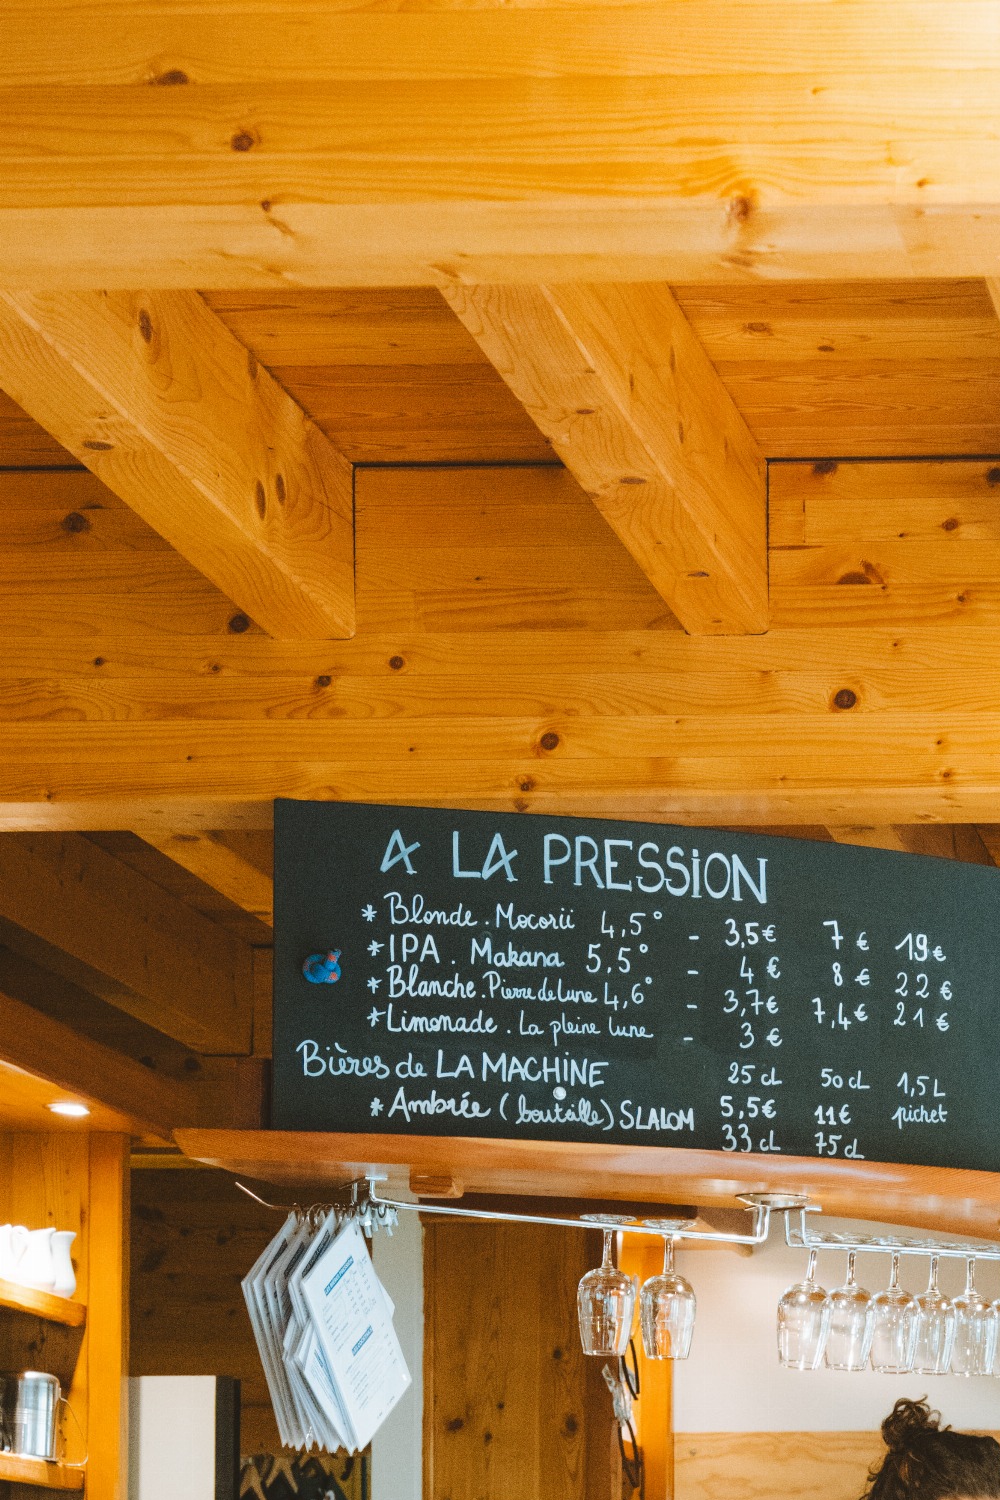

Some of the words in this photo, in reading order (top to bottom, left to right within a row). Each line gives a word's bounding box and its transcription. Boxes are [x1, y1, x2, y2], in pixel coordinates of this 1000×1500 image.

[380, 829, 421, 874] A
[453, 831, 518, 882] LA
[384, 892, 478, 925] Blonde
[390, 934, 440, 963] IPA
[471, 937, 565, 968] Makana
[387, 965, 476, 998] Blanche
[388, 1004, 497, 1034] Limonade
[520, 1011, 544, 1036] La
[549, 1016, 601, 1046] pleine
[297, 1039, 390, 1079] Bières
[396, 1053, 427, 1079] de
[437, 1050, 475, 1079] LA
[388, 1086, 491, 1123] Ambrée
[620, 1100, 694, 1132] SLALOM
[892, 1103, 948, 1129] pichet
